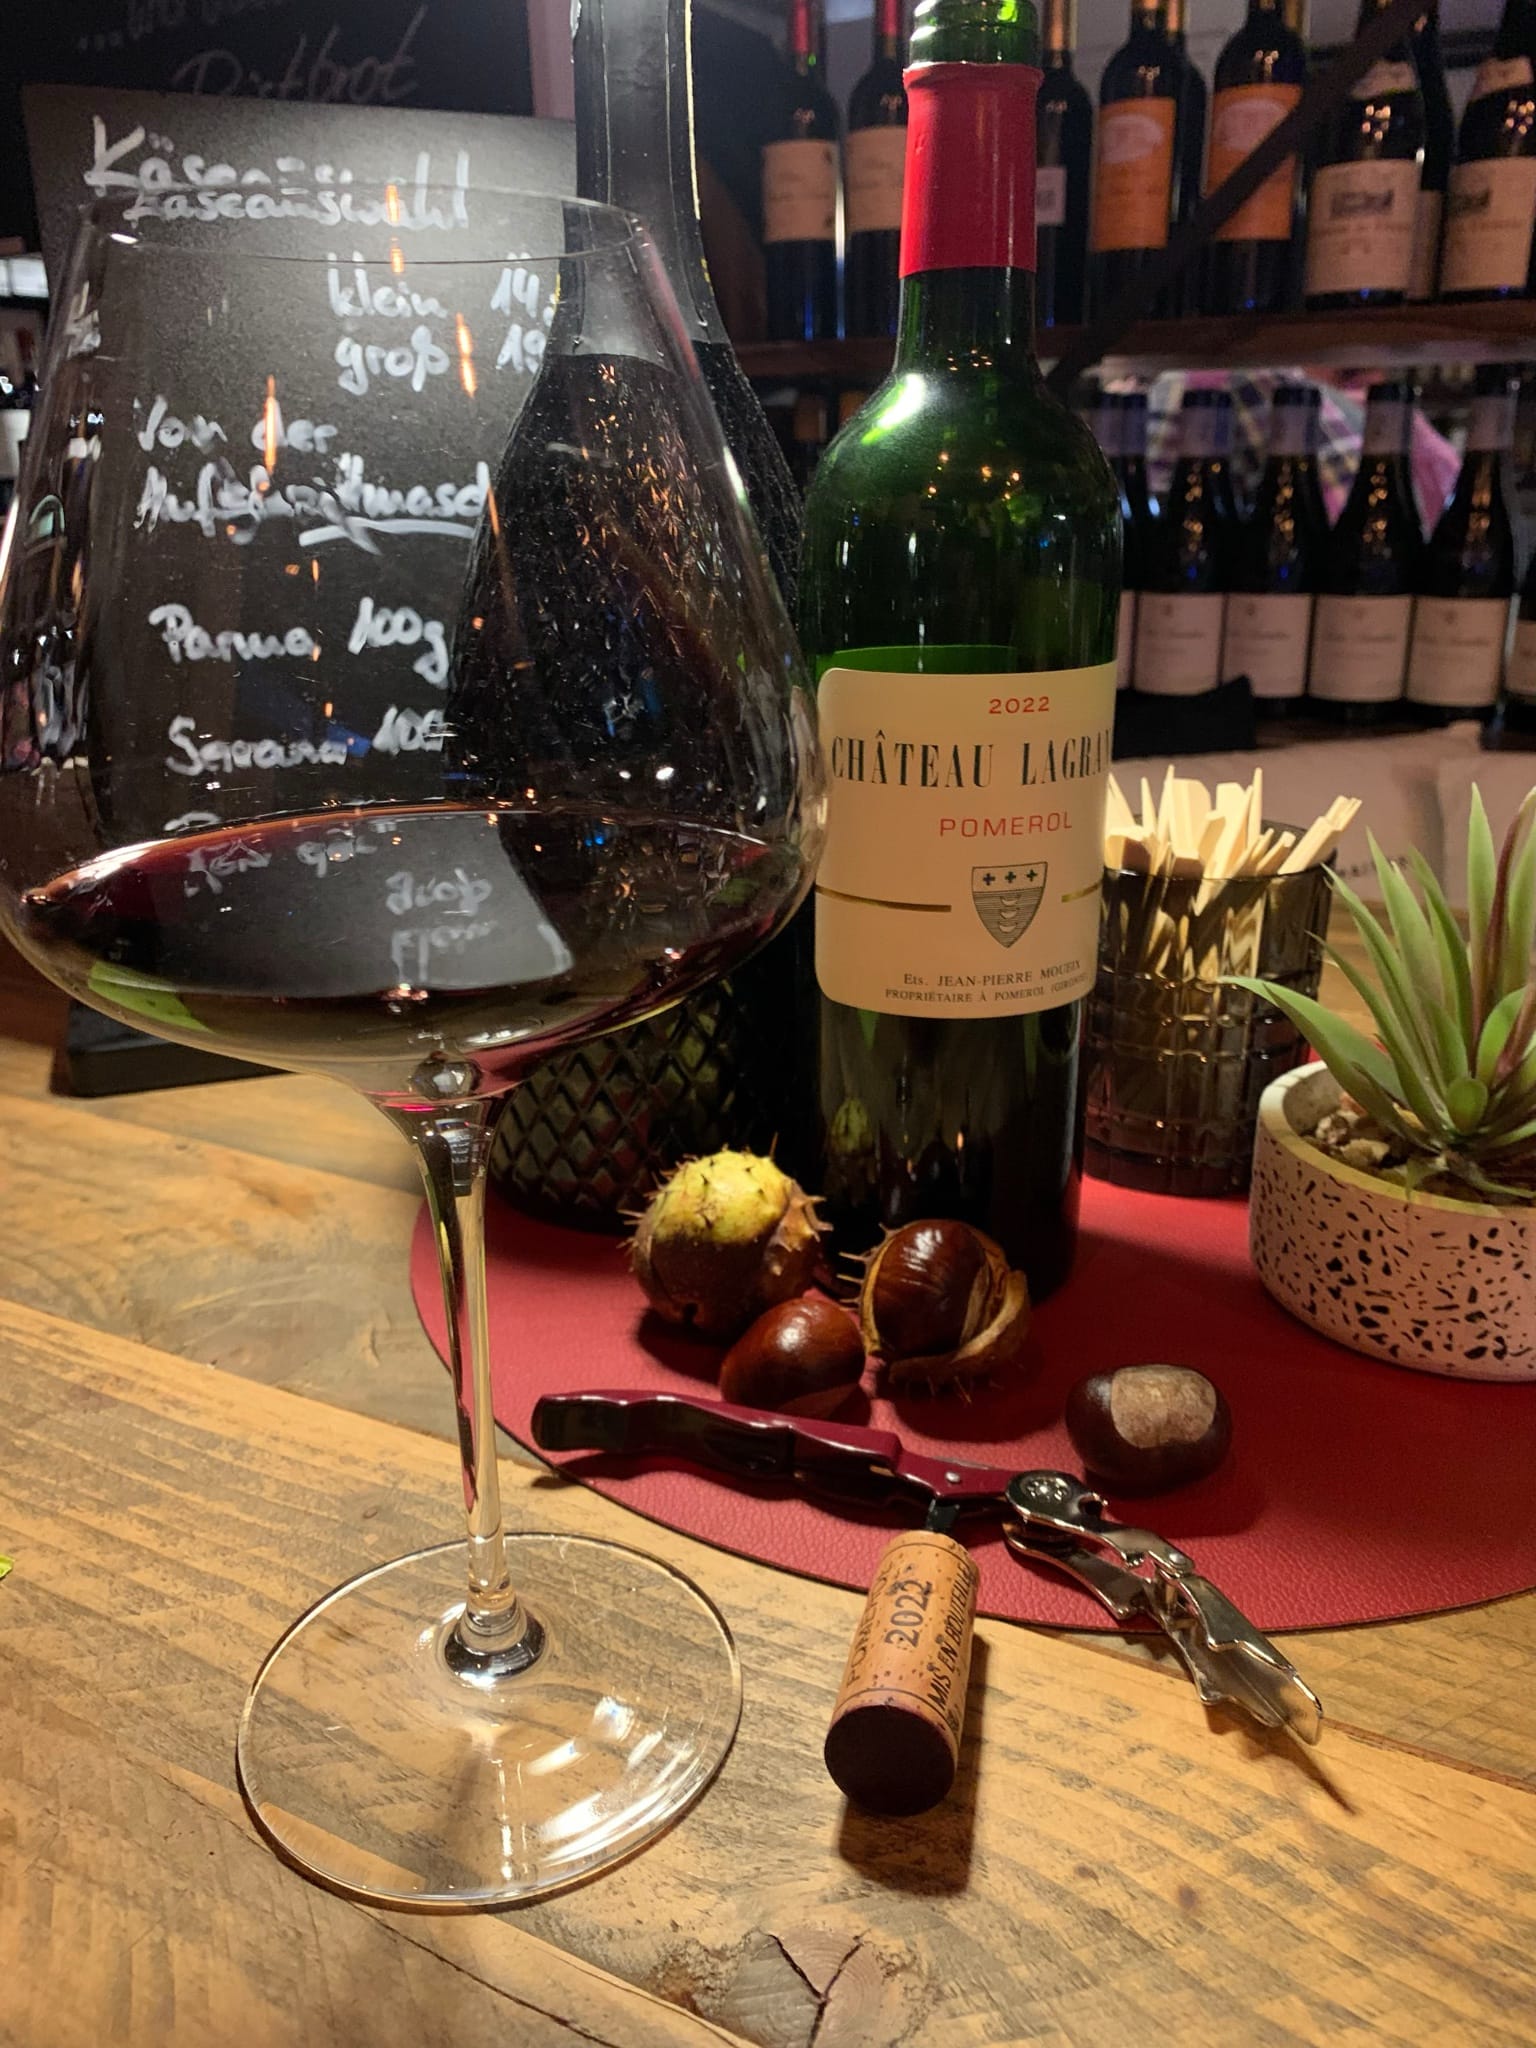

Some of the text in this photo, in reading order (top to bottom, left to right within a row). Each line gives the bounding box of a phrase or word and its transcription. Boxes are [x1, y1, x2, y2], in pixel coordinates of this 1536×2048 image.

[327, 252, 448, 319] klein
[334, 324, 450, 396] groß
[348, 596, 449, 689] 100g
[988, 696, 1050, 714] 2022
[831, 729, 993, 788] CHÂTEAU
[939, 811, 1072, 838] POMEROL
[903, 973, 929, 987] Ets.
[937, 970, 1033, 987] JEAN-PIERRE
[994, 986, 1045, 1001] POMEROL
[884, 1578, 933, 1648] 2022
[937, 1640, 959, 1674] EN
[927, 1672, 951, 1711] MIS
